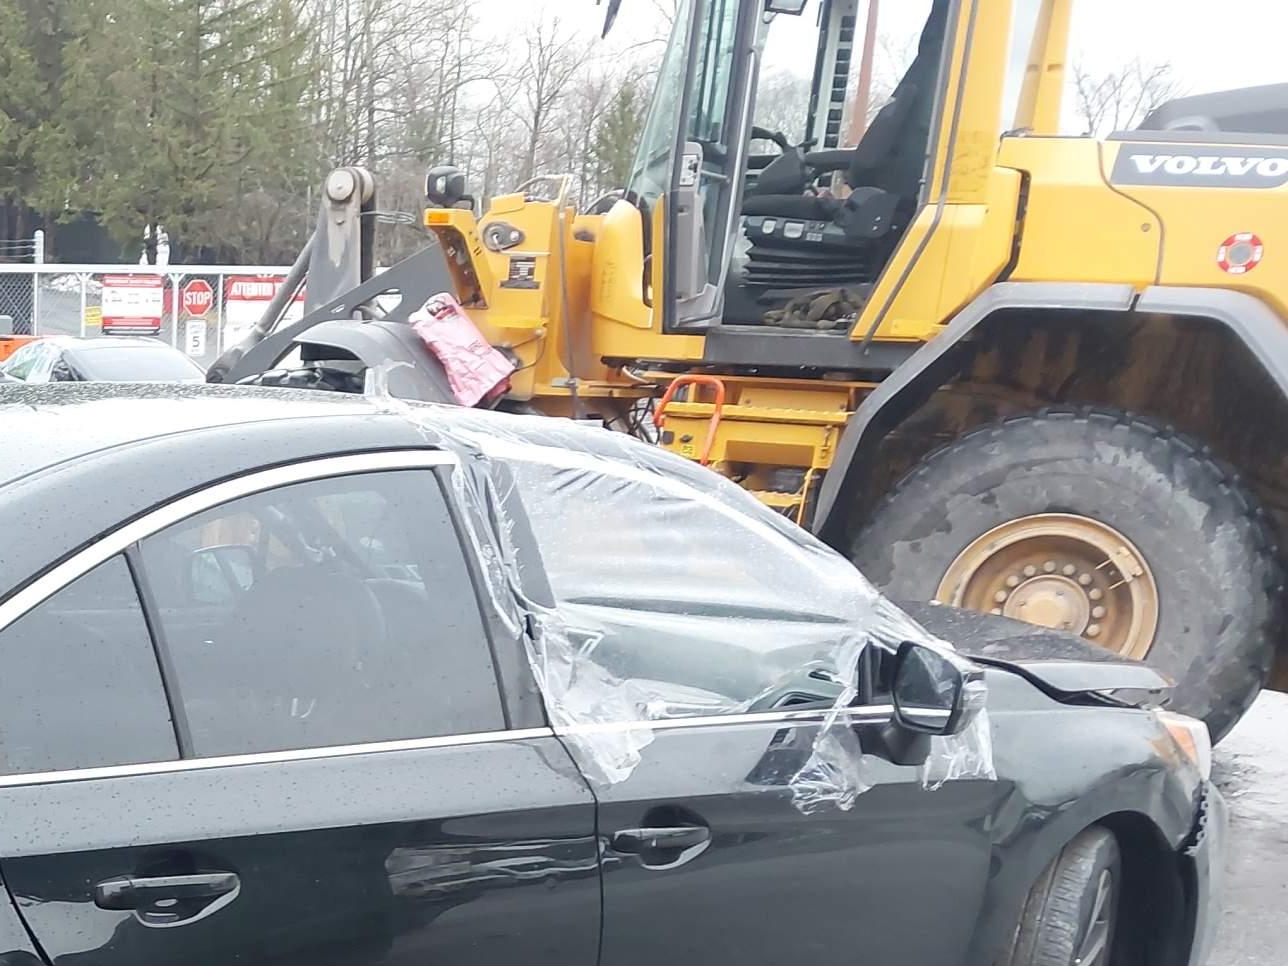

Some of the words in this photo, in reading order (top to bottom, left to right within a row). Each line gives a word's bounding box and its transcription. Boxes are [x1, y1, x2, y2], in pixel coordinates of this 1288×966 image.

[1130, 155, 1288, 177] VOLVO
[185, 291, 211, 305] STOP
[192, 336, 200, 347] 5
